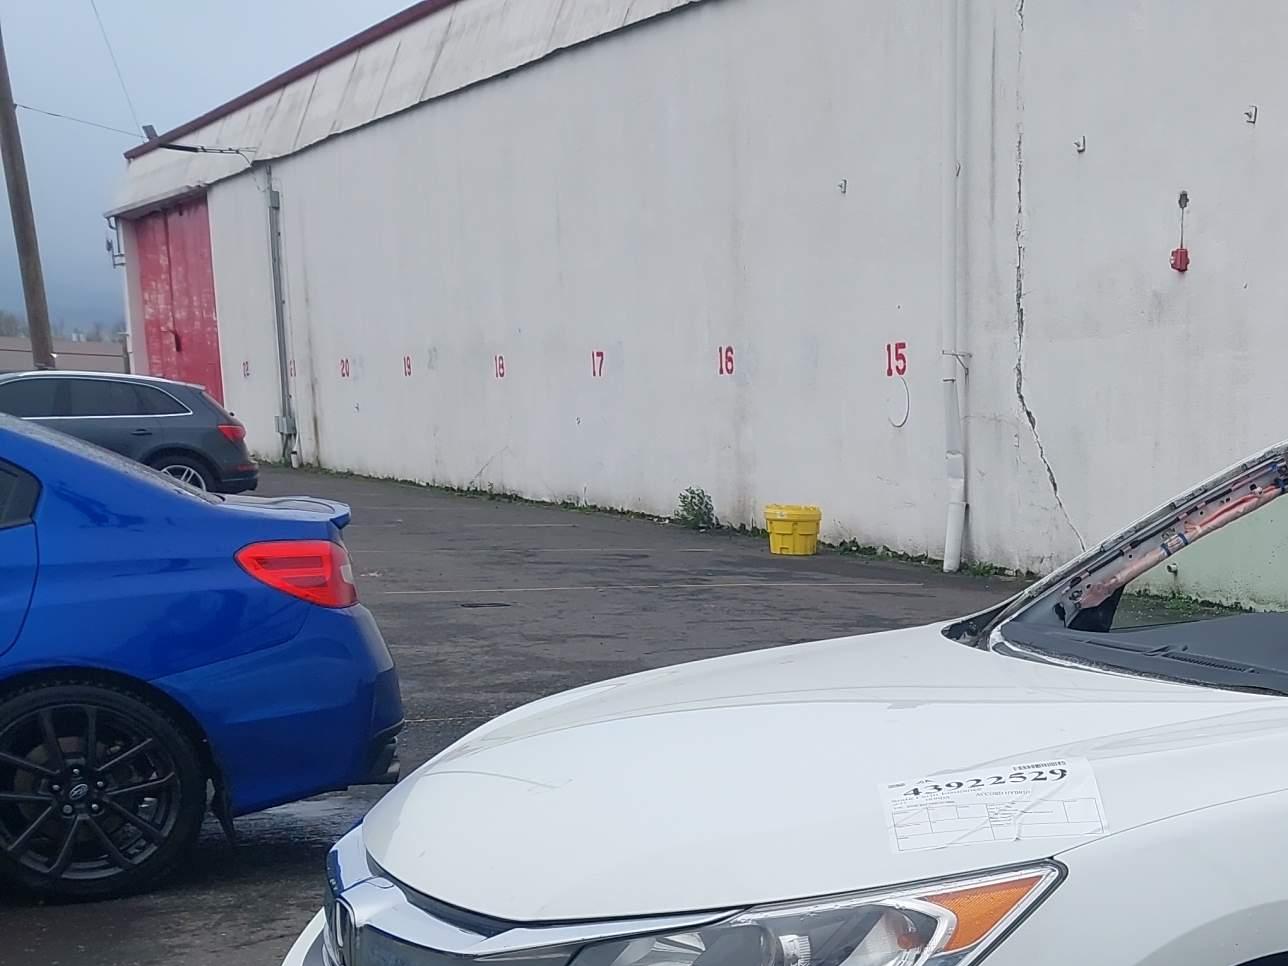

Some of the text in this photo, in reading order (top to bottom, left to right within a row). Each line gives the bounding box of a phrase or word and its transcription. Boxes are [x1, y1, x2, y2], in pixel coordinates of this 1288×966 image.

[340, 359, 350, 378] 20
[403, 356, 412, 376] 19
[494, 356, 505, 378] 18
[591, 351, 604, 377] 17
[718, 346, 735, 376] 16
[886, 342, 907, 377] 15
[903, 768, 1067, 797] 43922529
